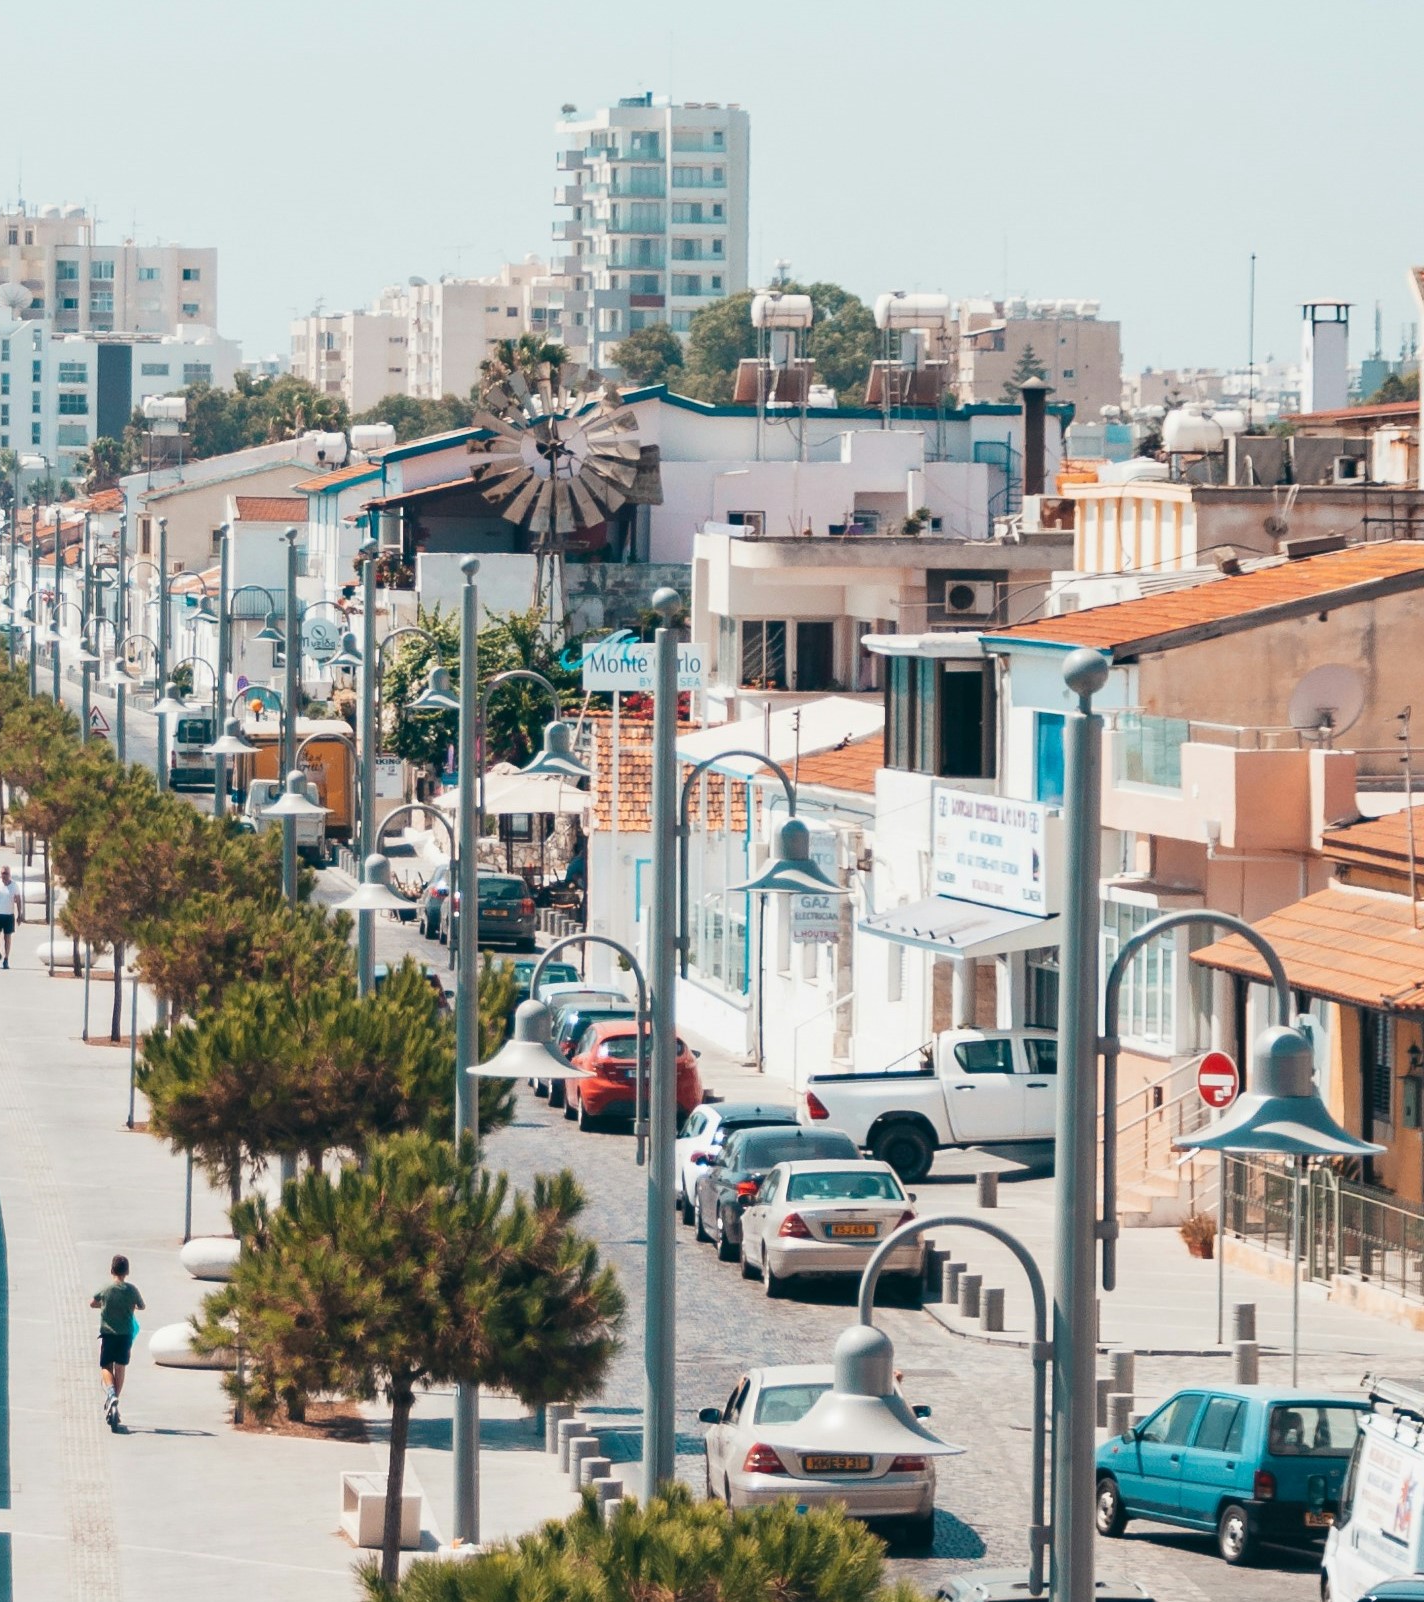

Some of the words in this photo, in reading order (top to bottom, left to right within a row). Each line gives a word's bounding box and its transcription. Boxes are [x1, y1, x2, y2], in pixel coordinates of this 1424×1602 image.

[589, 652, 648, 673] Monte
[639, 677, 652, 687] BY
[679, 677, 701, 687] SEA
[801, 896, 830, 909] GAZ
[794, 912, 838, 920] ELECTRICIAN
